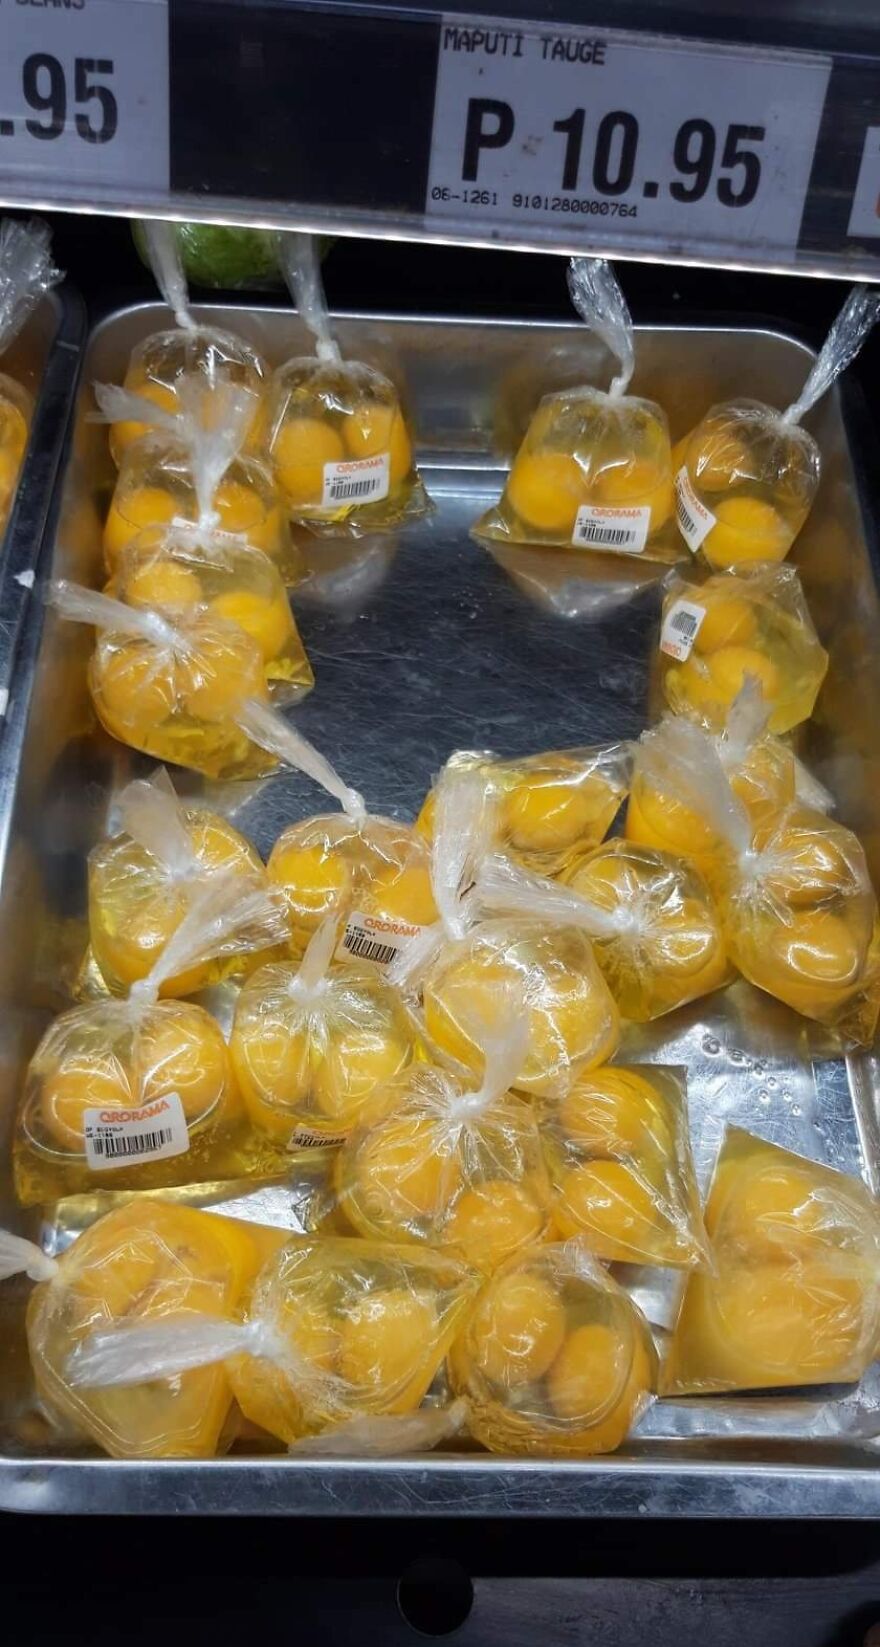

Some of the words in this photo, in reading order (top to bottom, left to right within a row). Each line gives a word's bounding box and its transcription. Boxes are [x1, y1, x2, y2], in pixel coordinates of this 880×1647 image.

[443, 28, 525, 57] MAPUTI
[540, 37, 608, 66] TAUGE
[461, 97, 516, 182] P
[552, 108, 767, 209] 10.95
[431, 186, 498, 206] 06-1261
[511, 193, 638, 218] 9101280000764
[99, 1100, 171, 1124] ORORAMA
